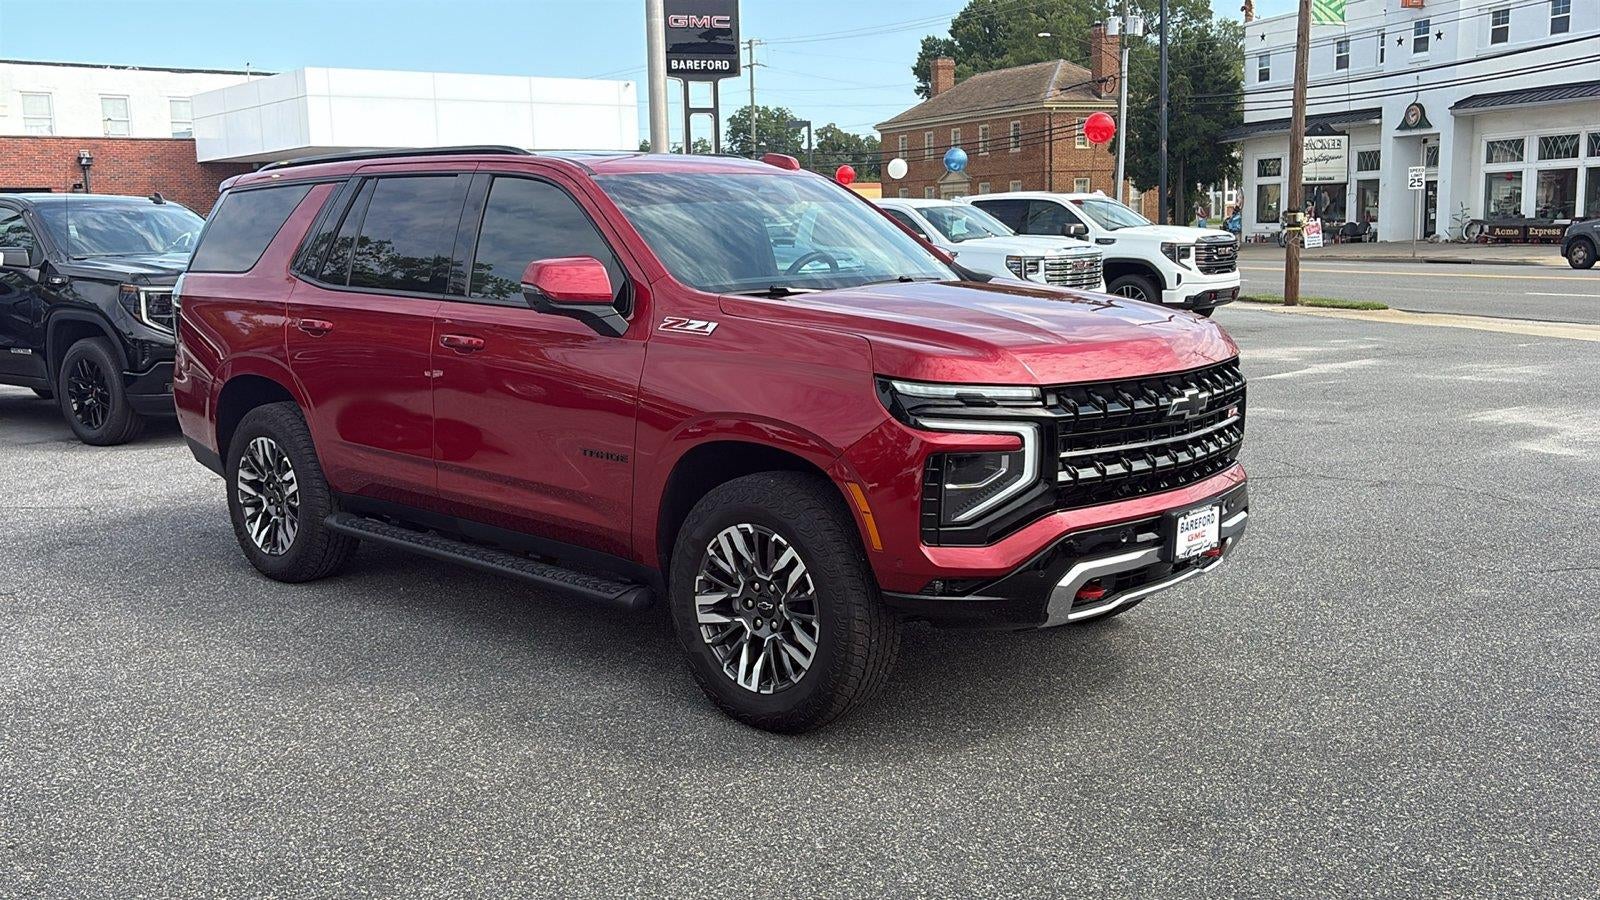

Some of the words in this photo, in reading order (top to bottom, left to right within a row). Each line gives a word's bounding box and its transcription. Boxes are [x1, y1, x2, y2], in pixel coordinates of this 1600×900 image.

[668, 14, 731, 29] GMC
[671, 60, 730, 70] BAREFORD
[1305, 138, 1342, 150] ACME
[1409, 178, 1424, 188] 25
[1494, 227, 1519, 236] Acme
[1529, 227, 1561, 237] Express
[658, 316, 719, 336] Z71
[580, 448, 629, 464] TAHOE
[1180, 513, 1216, 534] BAREFORD
[1187, 530, 1206, 542] GMC
